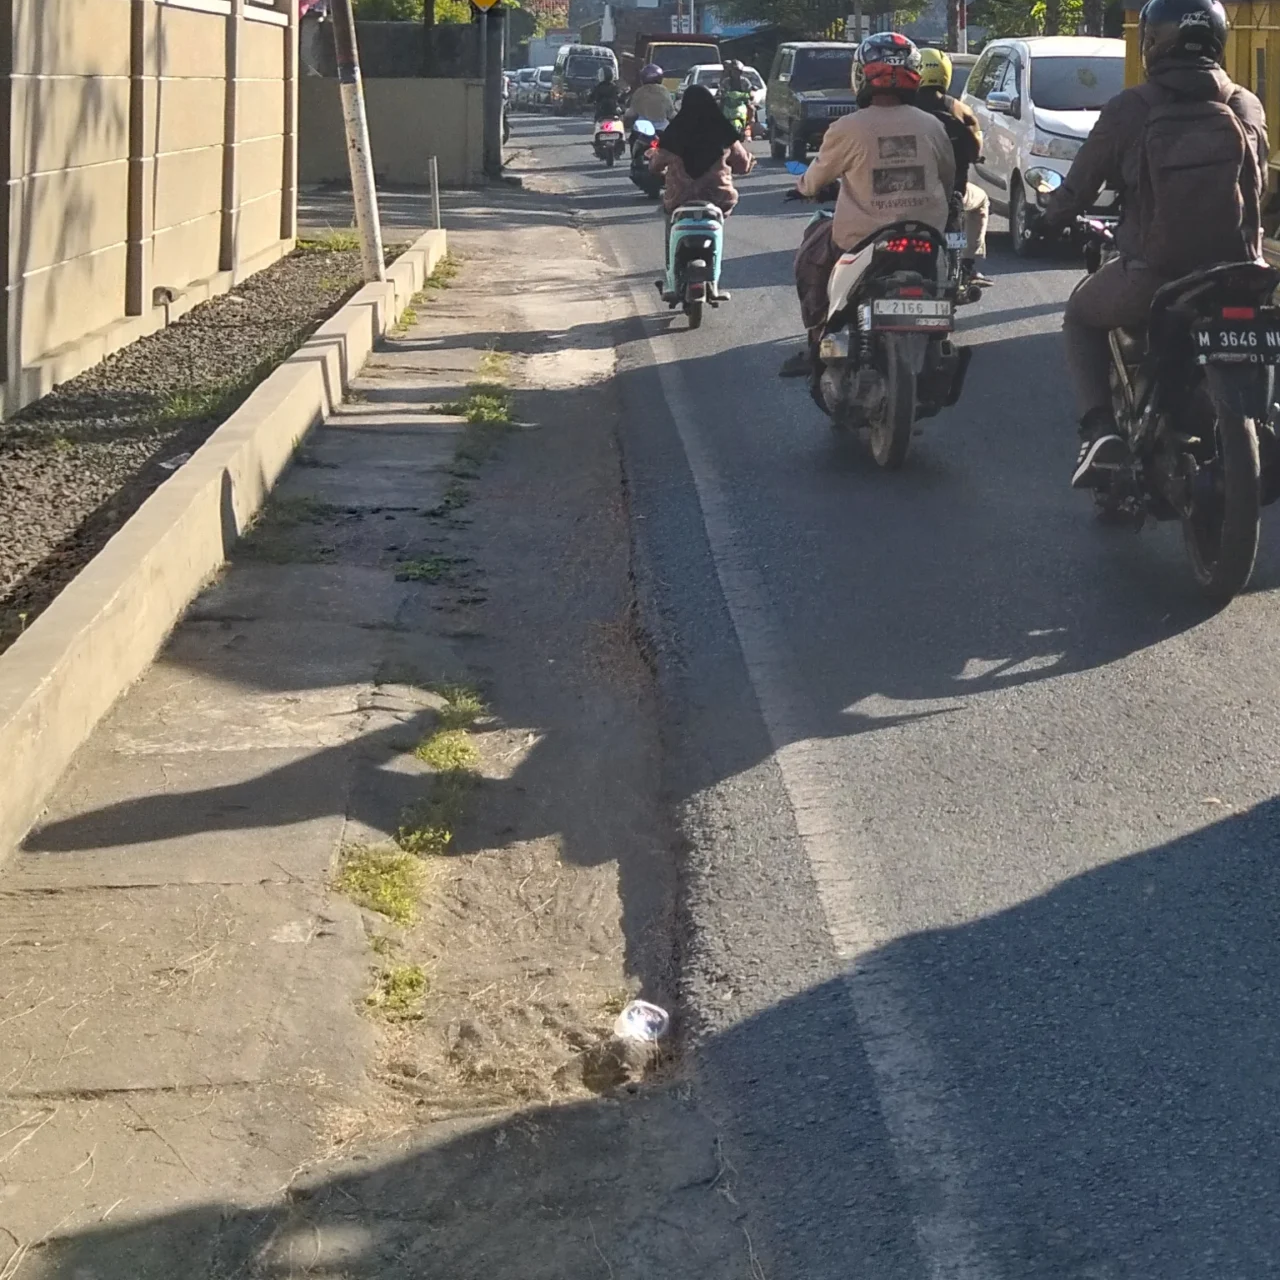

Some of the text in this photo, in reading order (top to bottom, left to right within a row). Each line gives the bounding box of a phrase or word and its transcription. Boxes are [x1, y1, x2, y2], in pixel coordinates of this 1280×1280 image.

[893, 302, 923, 314] 2166
[1198, 331, 1211, 347] M
[1219, 331, 1257, 346] 3646
